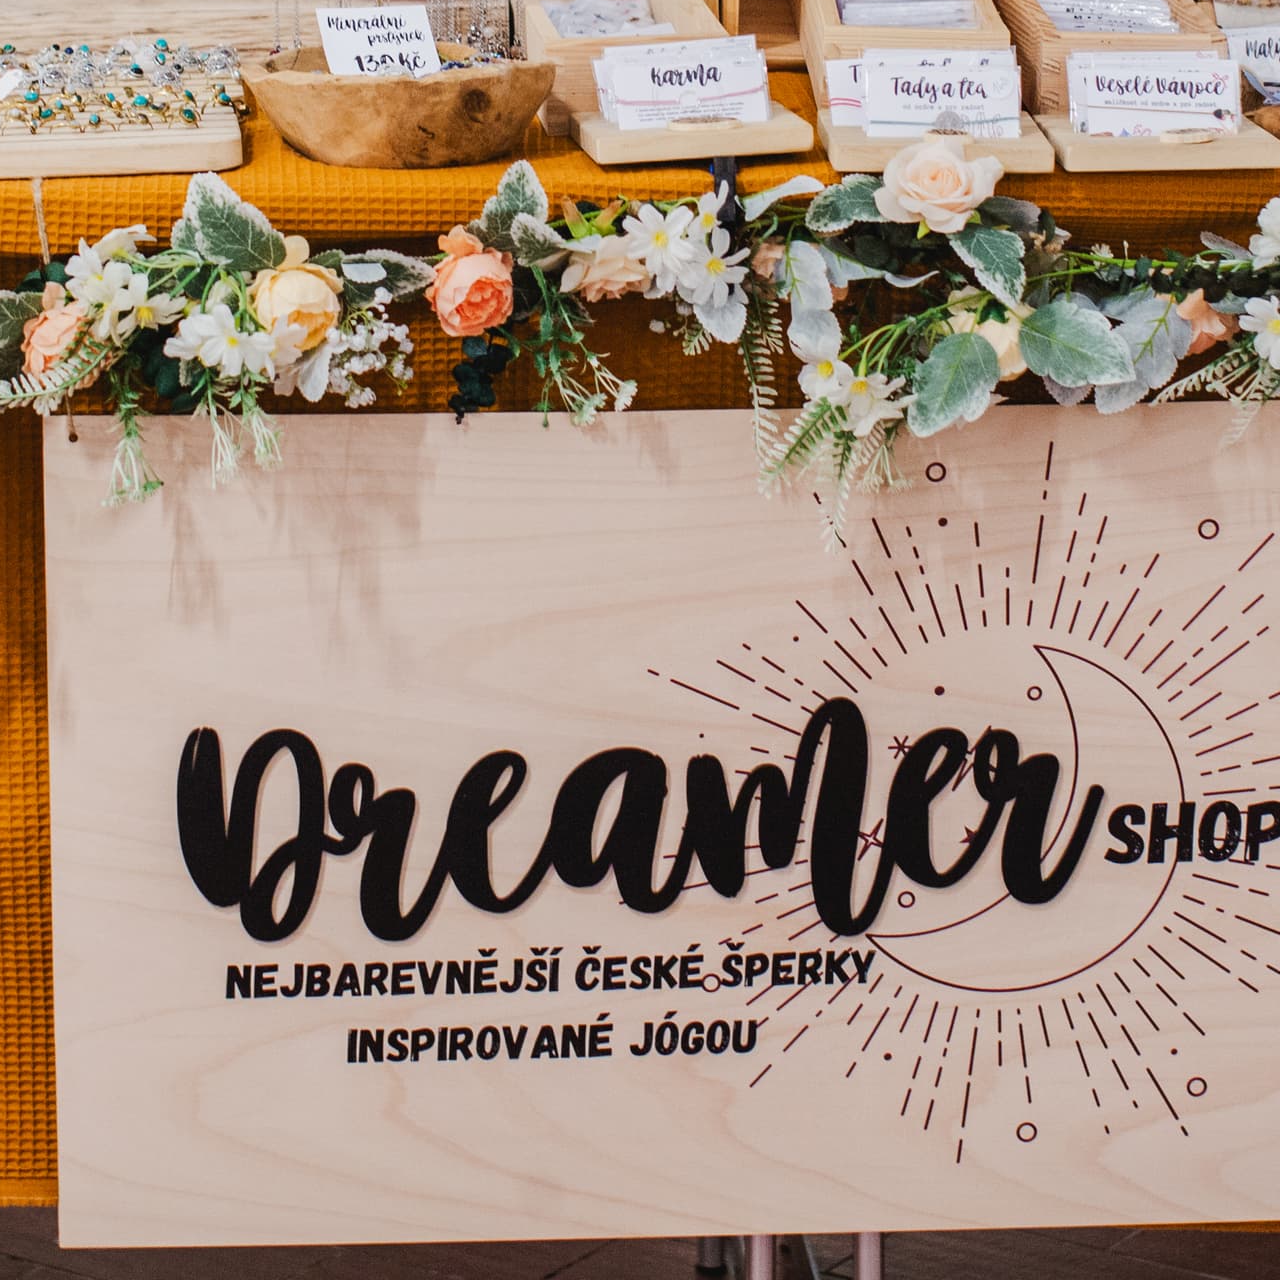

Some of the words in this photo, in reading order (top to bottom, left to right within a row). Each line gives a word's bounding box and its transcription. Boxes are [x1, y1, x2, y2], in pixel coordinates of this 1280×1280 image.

[890, 76, 939, 104] Tady
[942, 81, 955, 98] a
[1095, 74, 1155, 97] Veselé
[1156, 75, 1226, 100] Vánoce
[176, 696, 1106, 944] Dreamer
[224, 944, 563, 1002] NEJBAREVNĚJŠÍ
[574, 942, 710, 993] ČESKÉ
[719, 940, 878, 990] ŠPERKY
[345, 1013, 615, 1065] INSPIROVANÉ
[629, 1010, 760, 1059] JÓGOU
